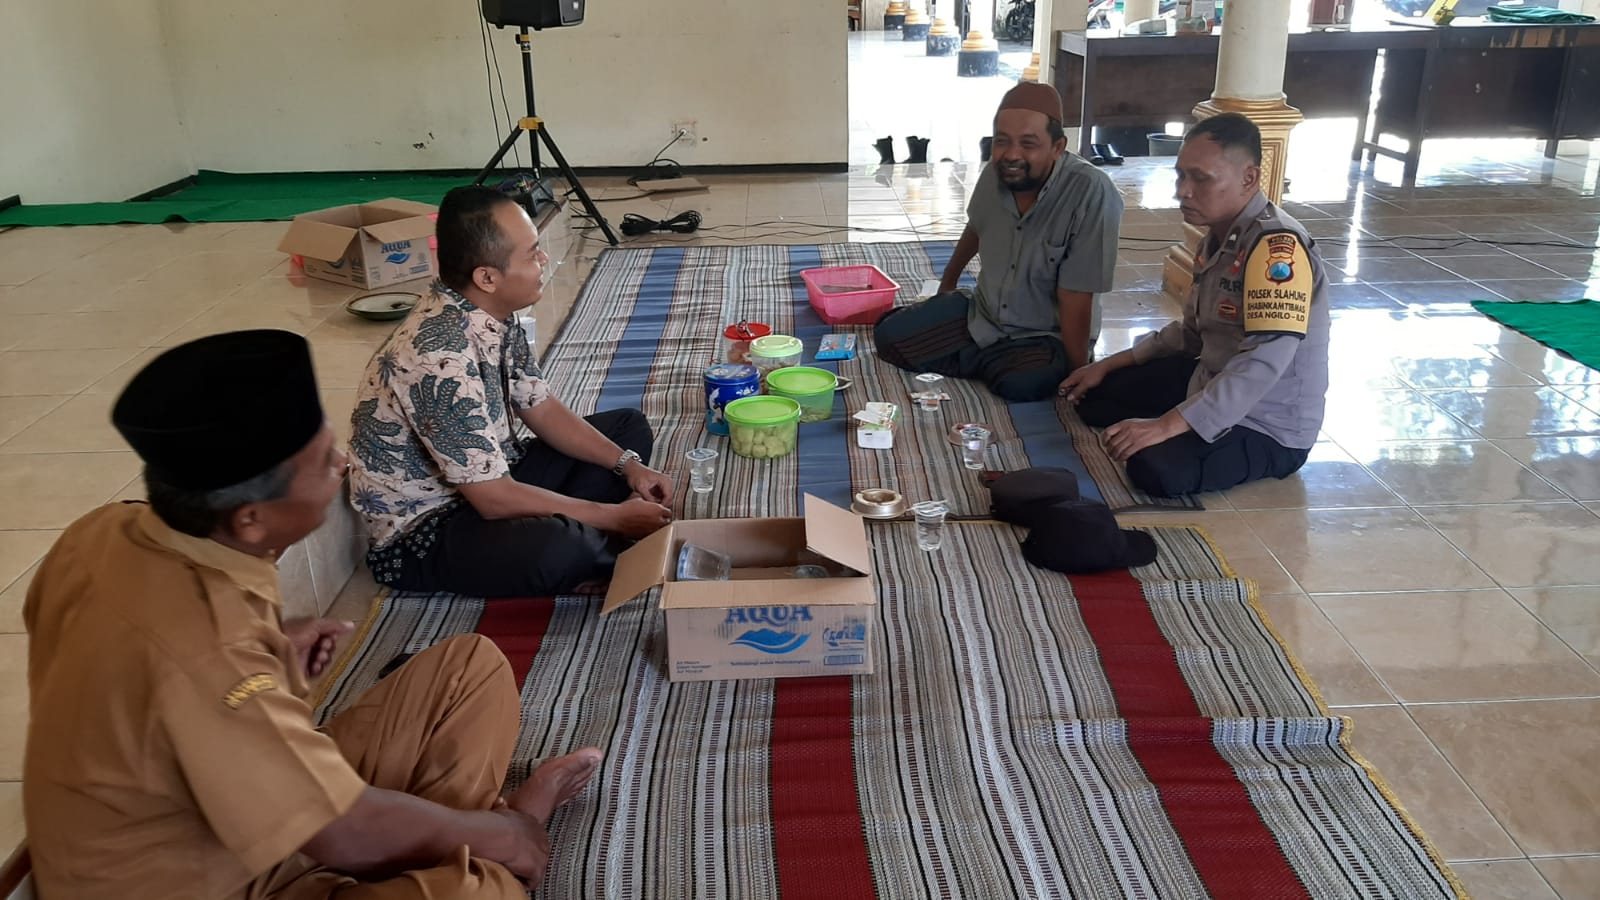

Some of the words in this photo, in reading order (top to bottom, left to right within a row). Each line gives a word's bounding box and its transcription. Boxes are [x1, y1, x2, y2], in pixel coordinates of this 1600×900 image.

[381, 240, 411, 253] AQUA
[1248, 289, 1272, 299] POLSEK
[1274, 289, 1306, 302] SLAHUNG
[725, 605, 814, 627] AQUA
